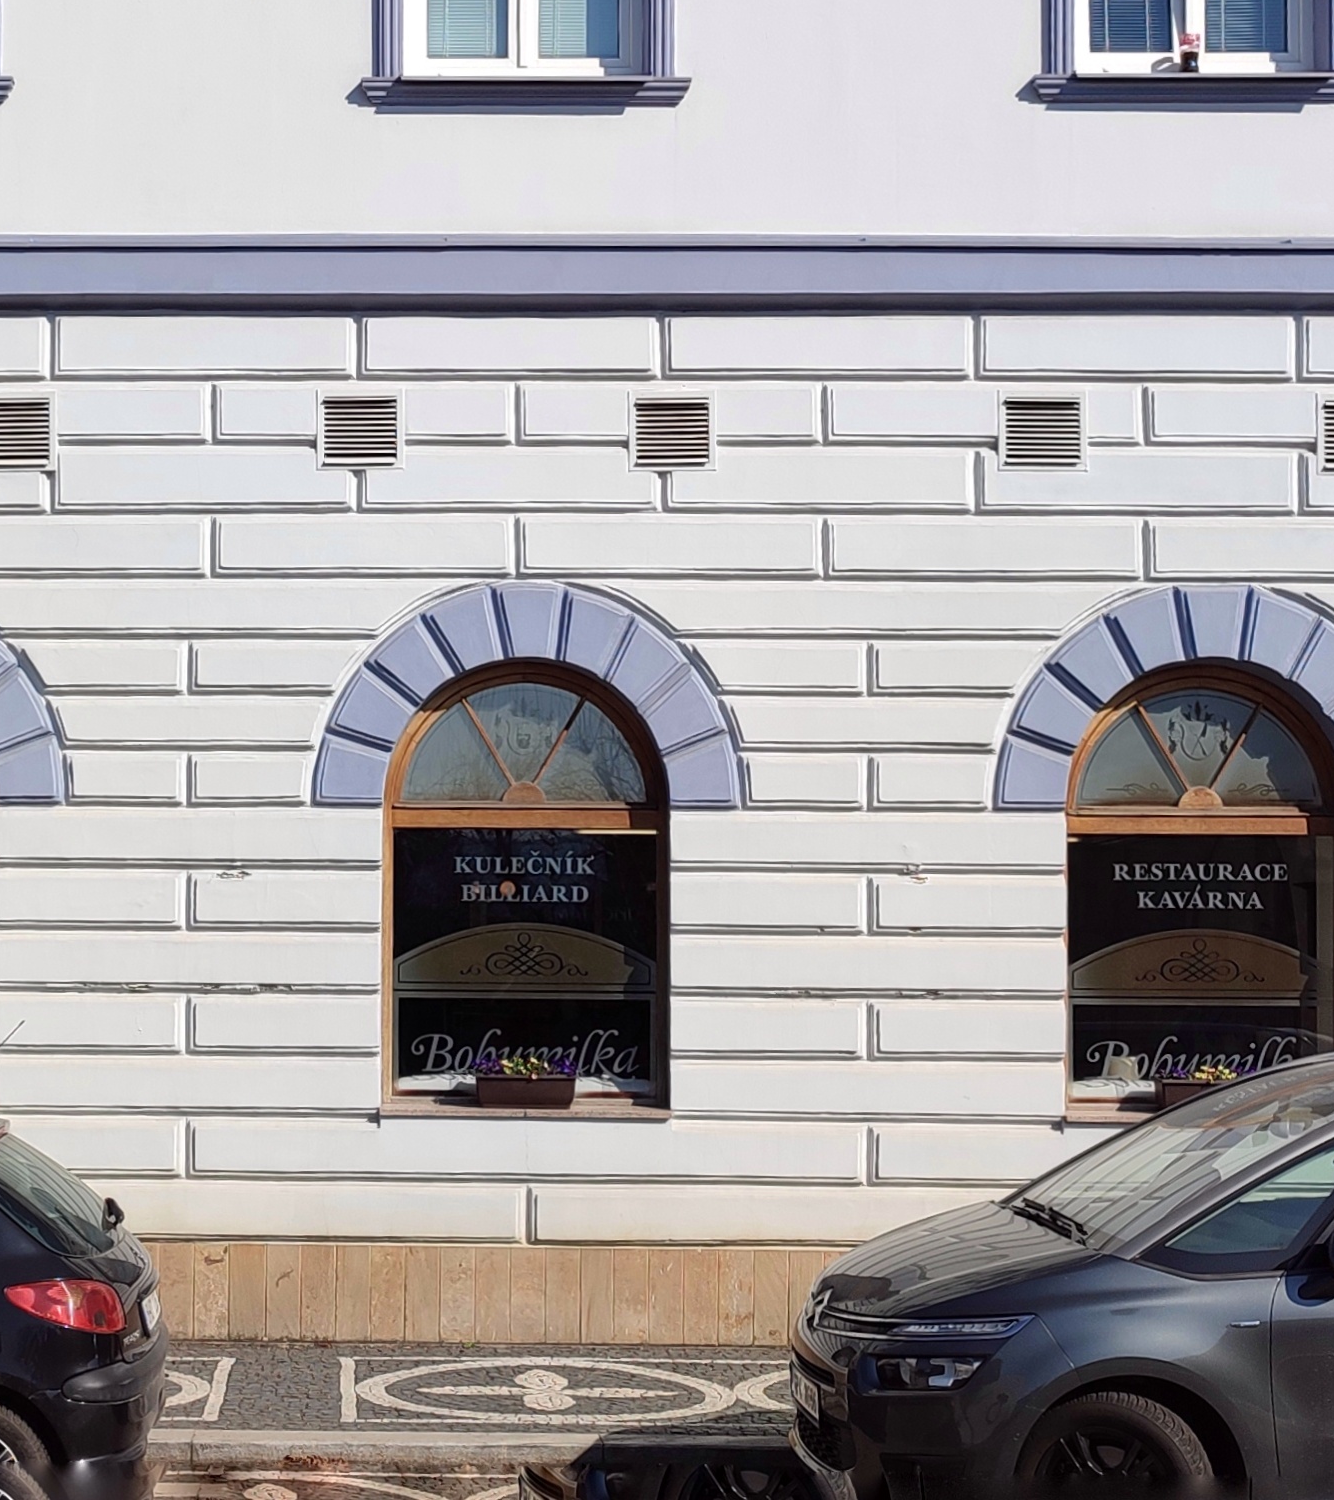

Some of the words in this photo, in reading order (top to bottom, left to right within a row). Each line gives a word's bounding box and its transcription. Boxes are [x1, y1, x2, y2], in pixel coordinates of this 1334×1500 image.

[454, 850, 595, 875] KULEČNÍK
[1113, 863, 1288, 881] RESTAURACE
[461, 884, 590, 903] BILLIARD
[1137, 883, 1264, 909] KAVÁRNA
[1086, 1036, 1297, 1079] Bohumilk
